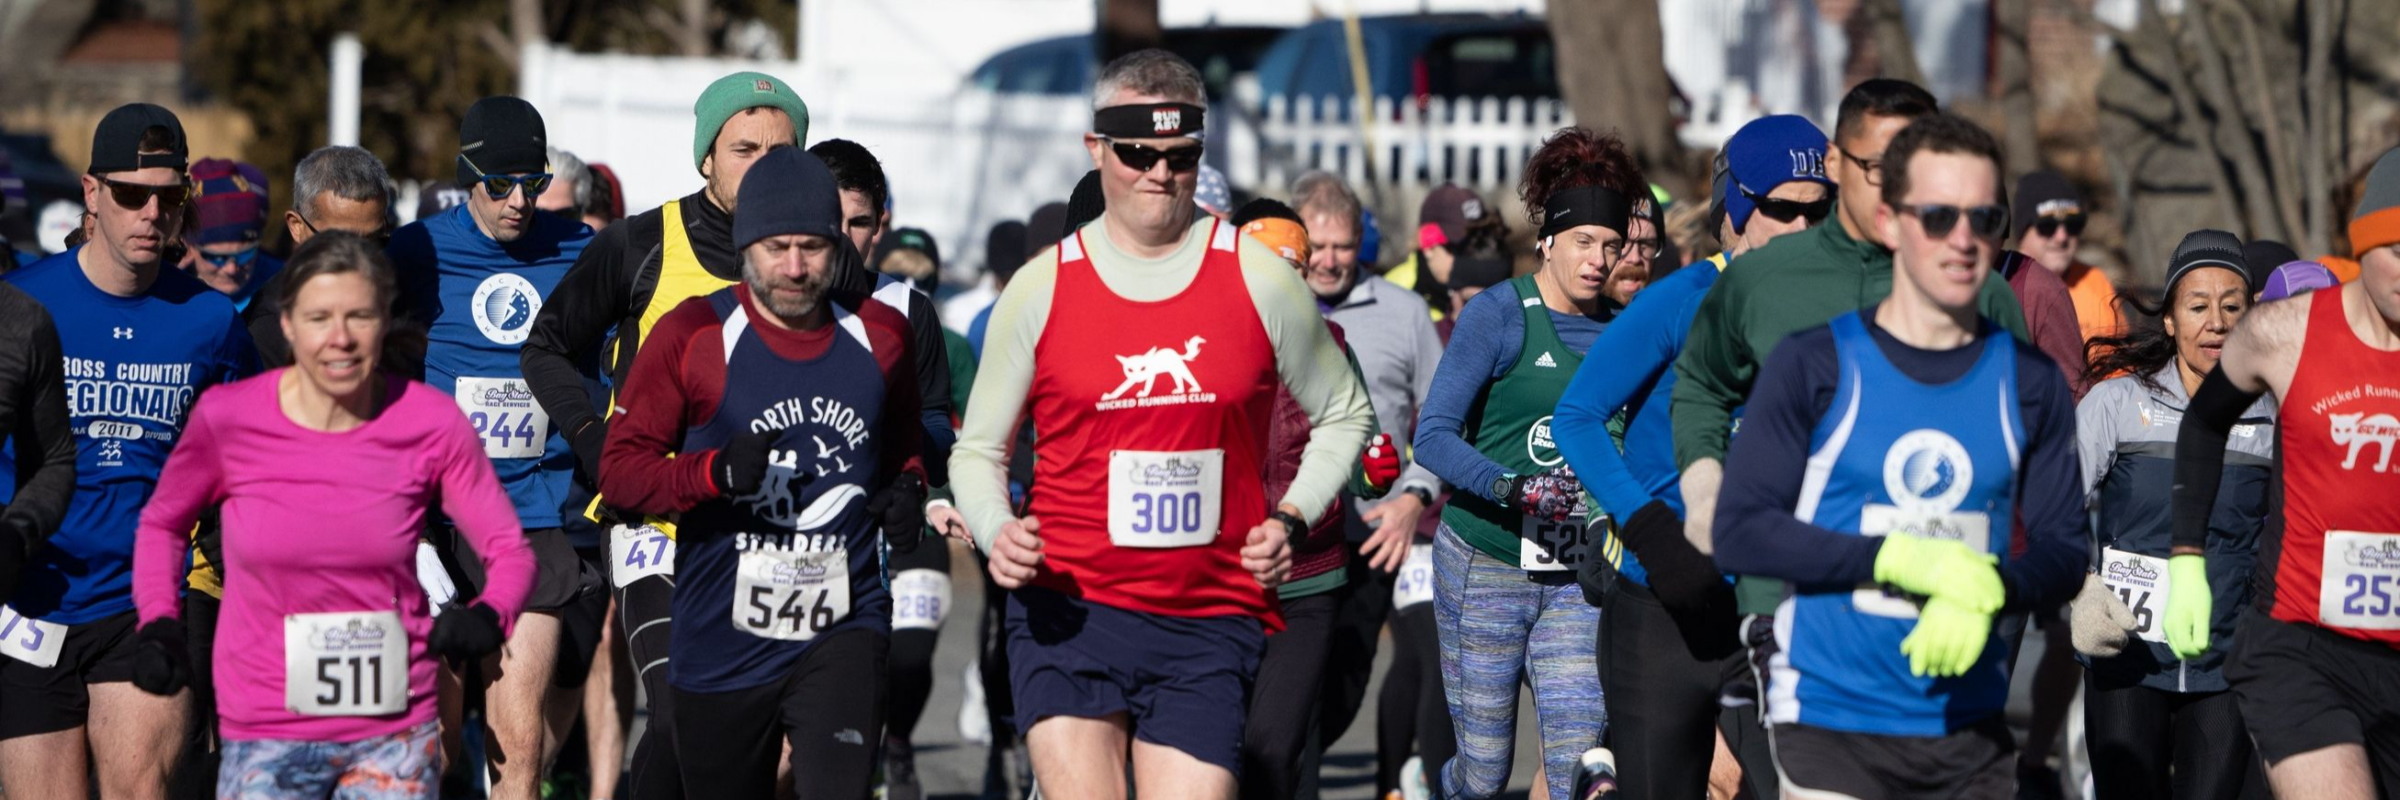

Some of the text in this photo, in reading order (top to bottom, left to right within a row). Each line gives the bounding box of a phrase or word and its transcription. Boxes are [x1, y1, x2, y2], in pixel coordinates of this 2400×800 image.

[1152, 110, 1181, 122] RUN
[476, 278, 540, 341] MYSTIC RUNRS
[63, 356, 192, 384] ROSS COUNTRY
[65, 379, 194, 430] EGIONALS
[485, 388, 532, 403] Bay State
[1095, 392, 1217, 411] WICKED RUNNING CLUB
[2311, 383, 2400, 415] Wicked Runn
[98, 423, 133, 437] 2011
[470, 411, 535, 448] 244
[751, 396, 870, 452] ORTH SHORE
[1132, 491, 1201, 534] 300
[735, 532, 848, 553] STRIDERS
[1398, 568, 1433, 595] 49
[2108, 574, 2155, 588] RACE SERVICES
[2109, 561, 2158, 580] Bay State
[747, 585, 834, 632] 546
[899, 595, 941, 622] 288
[2105, 584, 2153, 633] 16
[316, 656, 381, 705] 511
